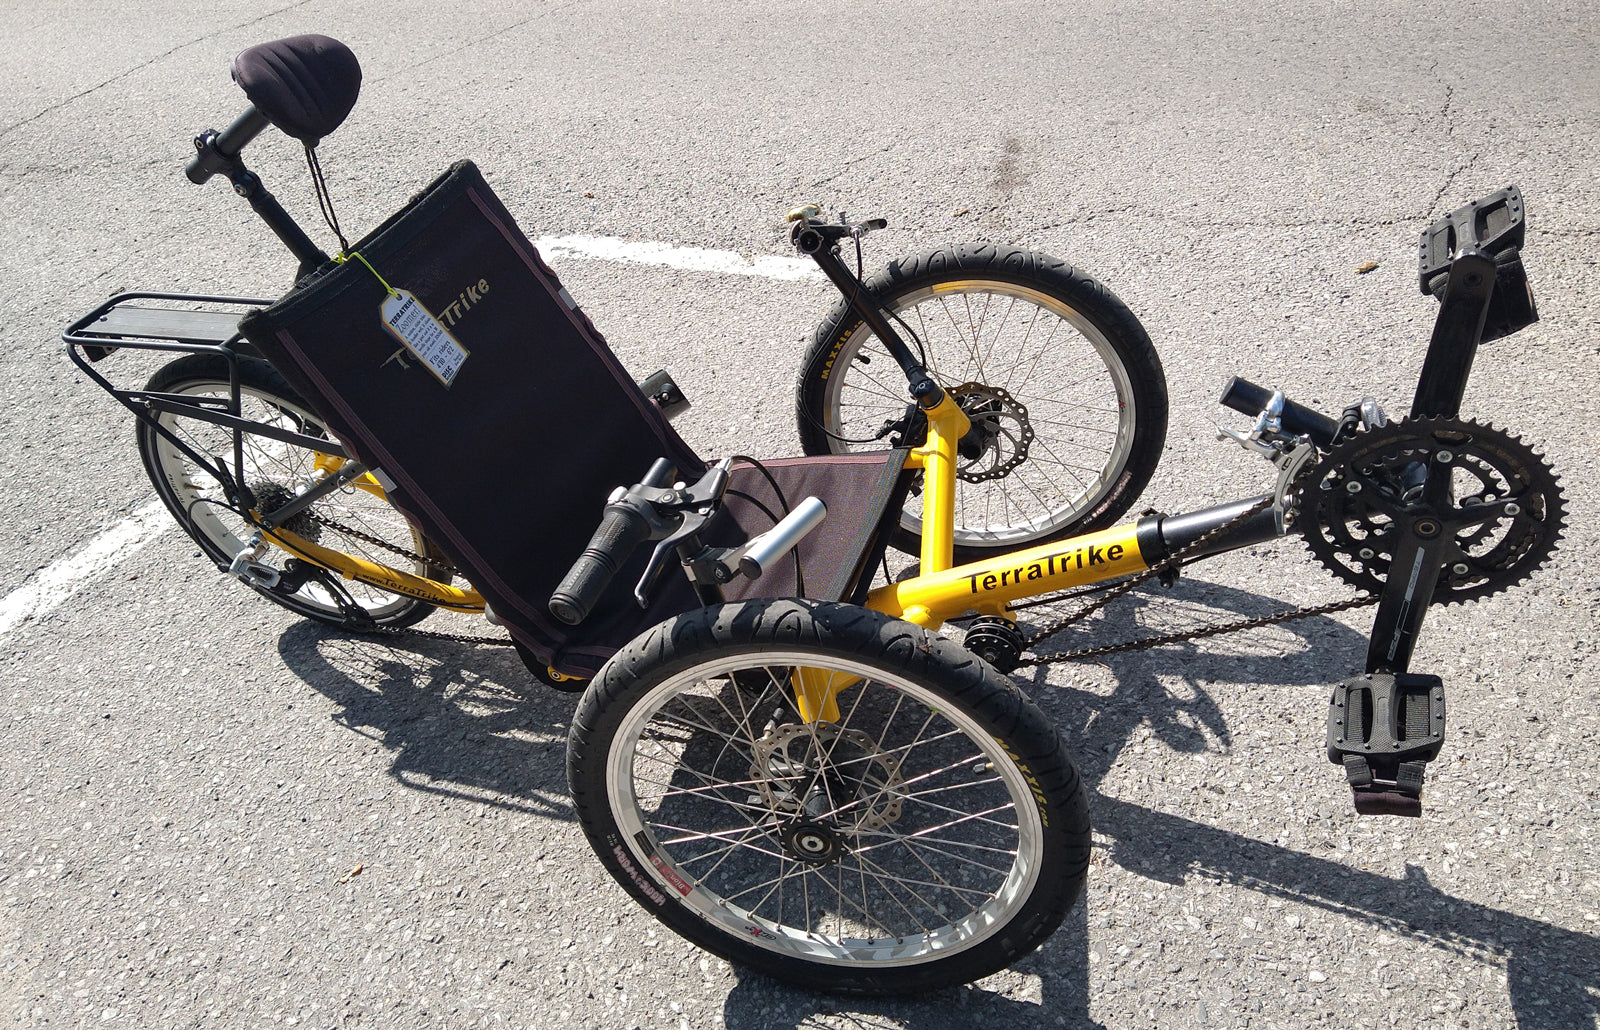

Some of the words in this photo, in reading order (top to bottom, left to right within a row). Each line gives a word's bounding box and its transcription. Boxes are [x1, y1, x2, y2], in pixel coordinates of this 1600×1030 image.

[389, 297, 416, 327] TERRATRIKE
[429, 353, 440, 365] Fits
[439, 340, 451, 355] riders
[957, 543, 1125, 594] TerraTrike
